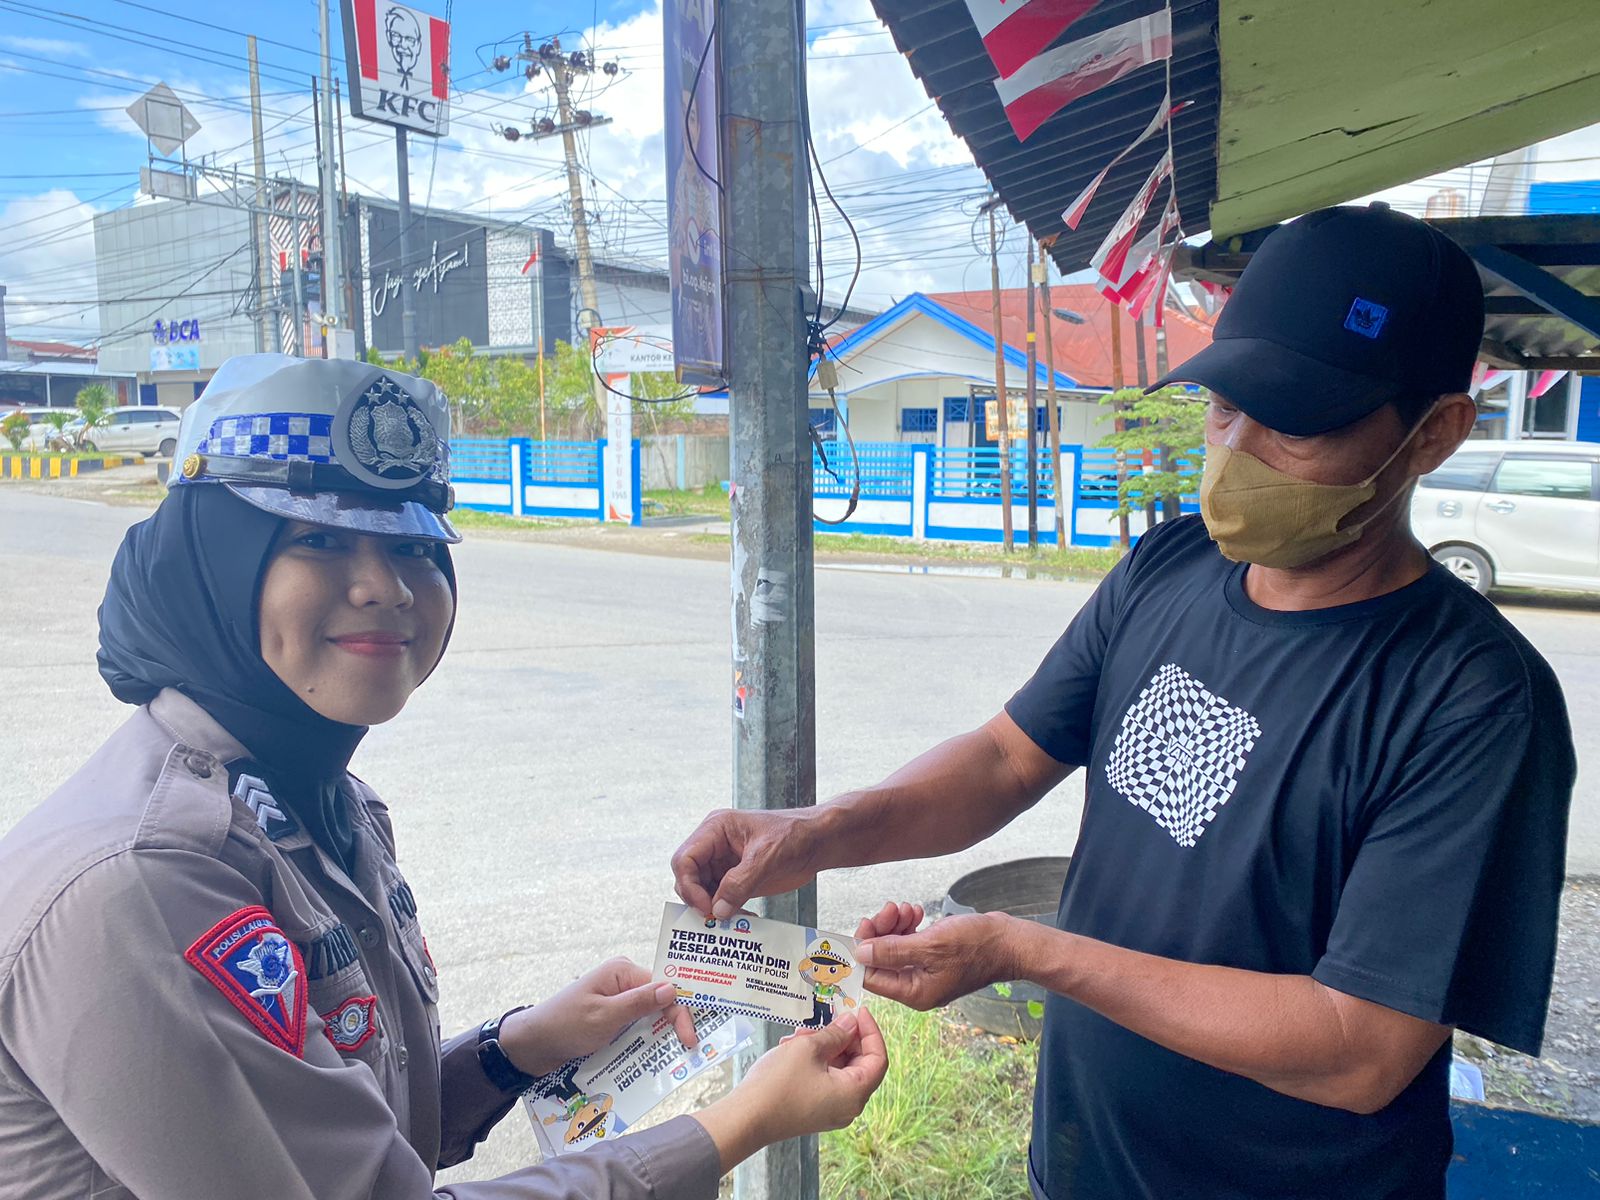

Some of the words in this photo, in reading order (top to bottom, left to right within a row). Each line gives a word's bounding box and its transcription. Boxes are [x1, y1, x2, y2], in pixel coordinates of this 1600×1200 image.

[376, 88, 436, 123] KFC
[169, 319, 200, 342] BCA
[630, 354, 661, 363] KANTOR
[212, 929, 242, 958] POLISI
[672, 929, 716, 944] TERTIB
[720, 935, 763, 953] UNTUK
[667, 951, 698, 962] BUKAN
[700, 956, 733, 968] KARENA
[736, 962, 763, 973] TAKUT
[764, 967, 789, 979] POLISI
[669, 940, 764, 964] KESELAMATAN
[766, 956, 791, 970] DIRI
[693, 975, 732, 986] KECELAKAAN
[694, 969, 737, 980] PELANGGARAN
[746, 977, 788, 990] KESELAMATAN
[745, 983, 765, 992] UNTUK
[765, 987, 807, 1000] KEMANUSIAAN
[695, 1009, 733, 1044] TERTI
[623, 1035, 643, 1053] UNTUK
[638, 1040, 662, 1062] TAKUT
[607, 1039, 645, 1075] KESELAMATAN
[613, 1061, 637, 1084] POLISI
[617, 1068, 642, 1092] DIRI
